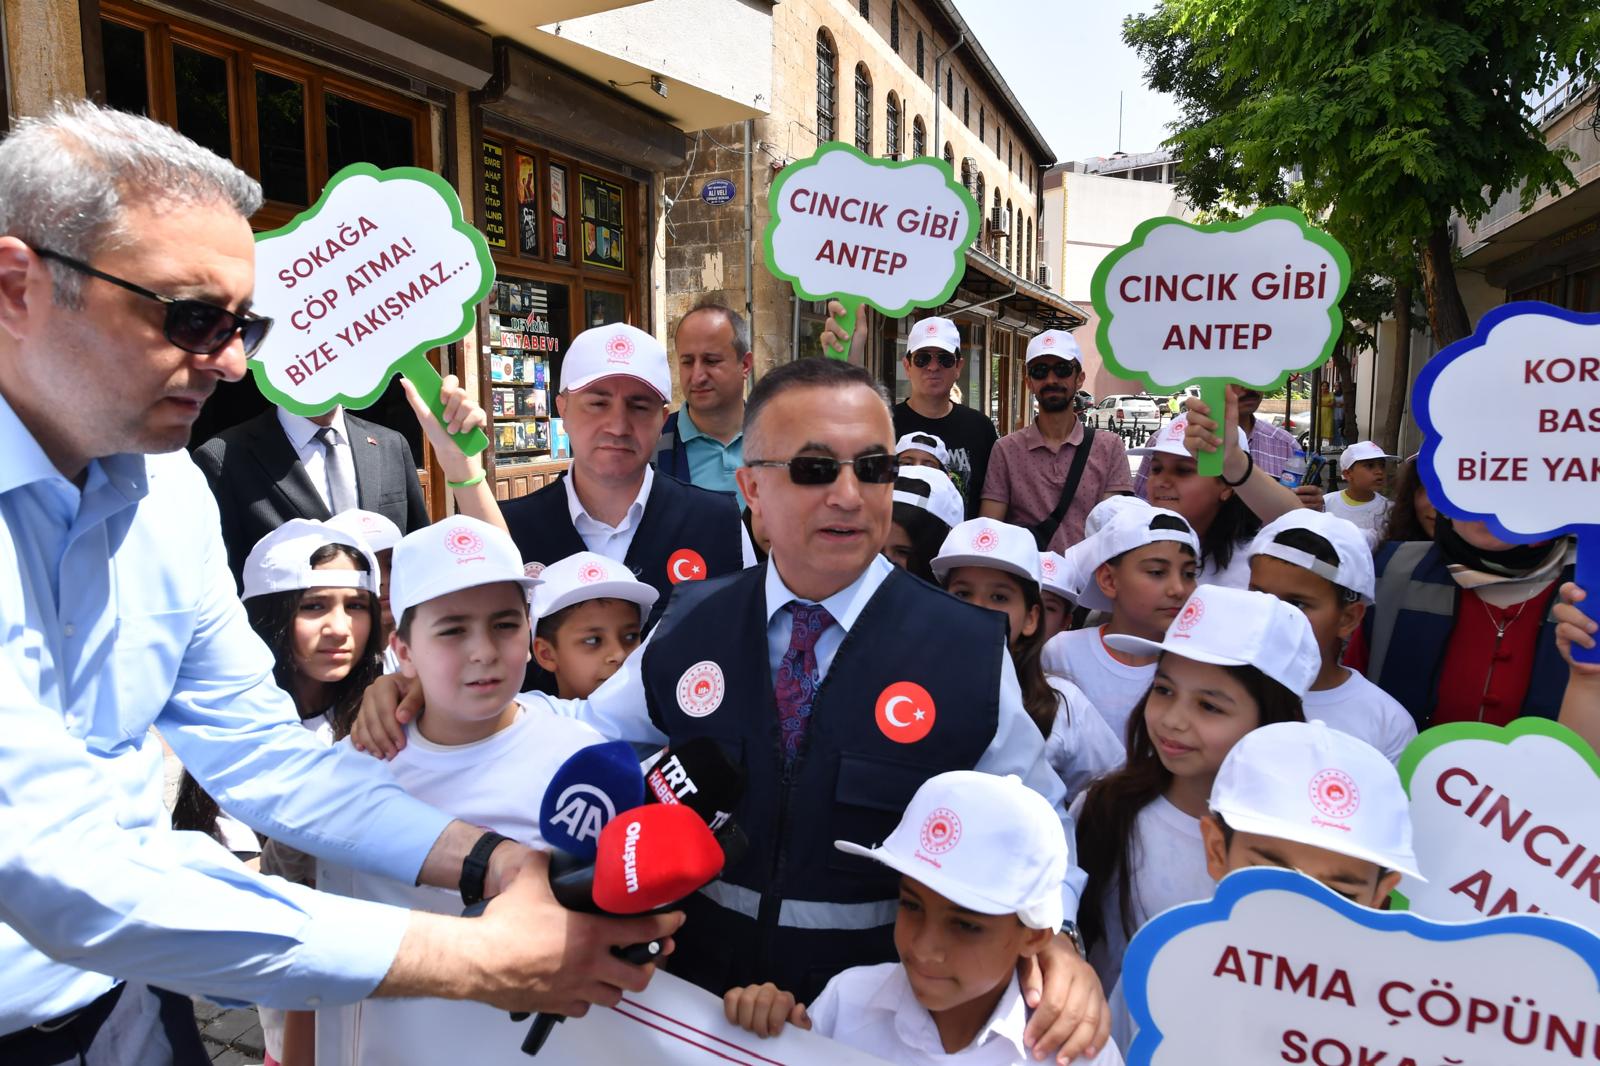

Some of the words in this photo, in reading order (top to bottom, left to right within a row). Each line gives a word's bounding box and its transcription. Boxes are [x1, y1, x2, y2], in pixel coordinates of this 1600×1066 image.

[790, 188, 889, 228] CINCIK
[897, 205, 960, 241] GİBİ
[278, 216, 379, 289] SOKAĞA
[815, 239, 907, 275] ANTEP
[290, 288, 338, 334] ÇÖP
[345, 236, 417, 296] ATMA!
[1119, 272, 1239, 303] CINCIK
[1251, 263, 1328, 300] GİBİ
[285, 342, 338, 386] BİZE
[336, 261, 470, 348] YAKIŞMAZ...
[500, 332, 559, 352] KİTABEVİ
[1162, 323, 1273, 351] ANTEP
[1458, 451, 1528, 481] BİZE
[661, 754, 698, 799] TRT
[622, 821, 641, 893] oluşum
[1449, 869, 1550, 918] AN
[1213, 945, 1356, 1007] ATMA
[1378, 978, 1600, 1060] ÇÖPÜN
[1280, 1029, 1463, 1066] SOK
